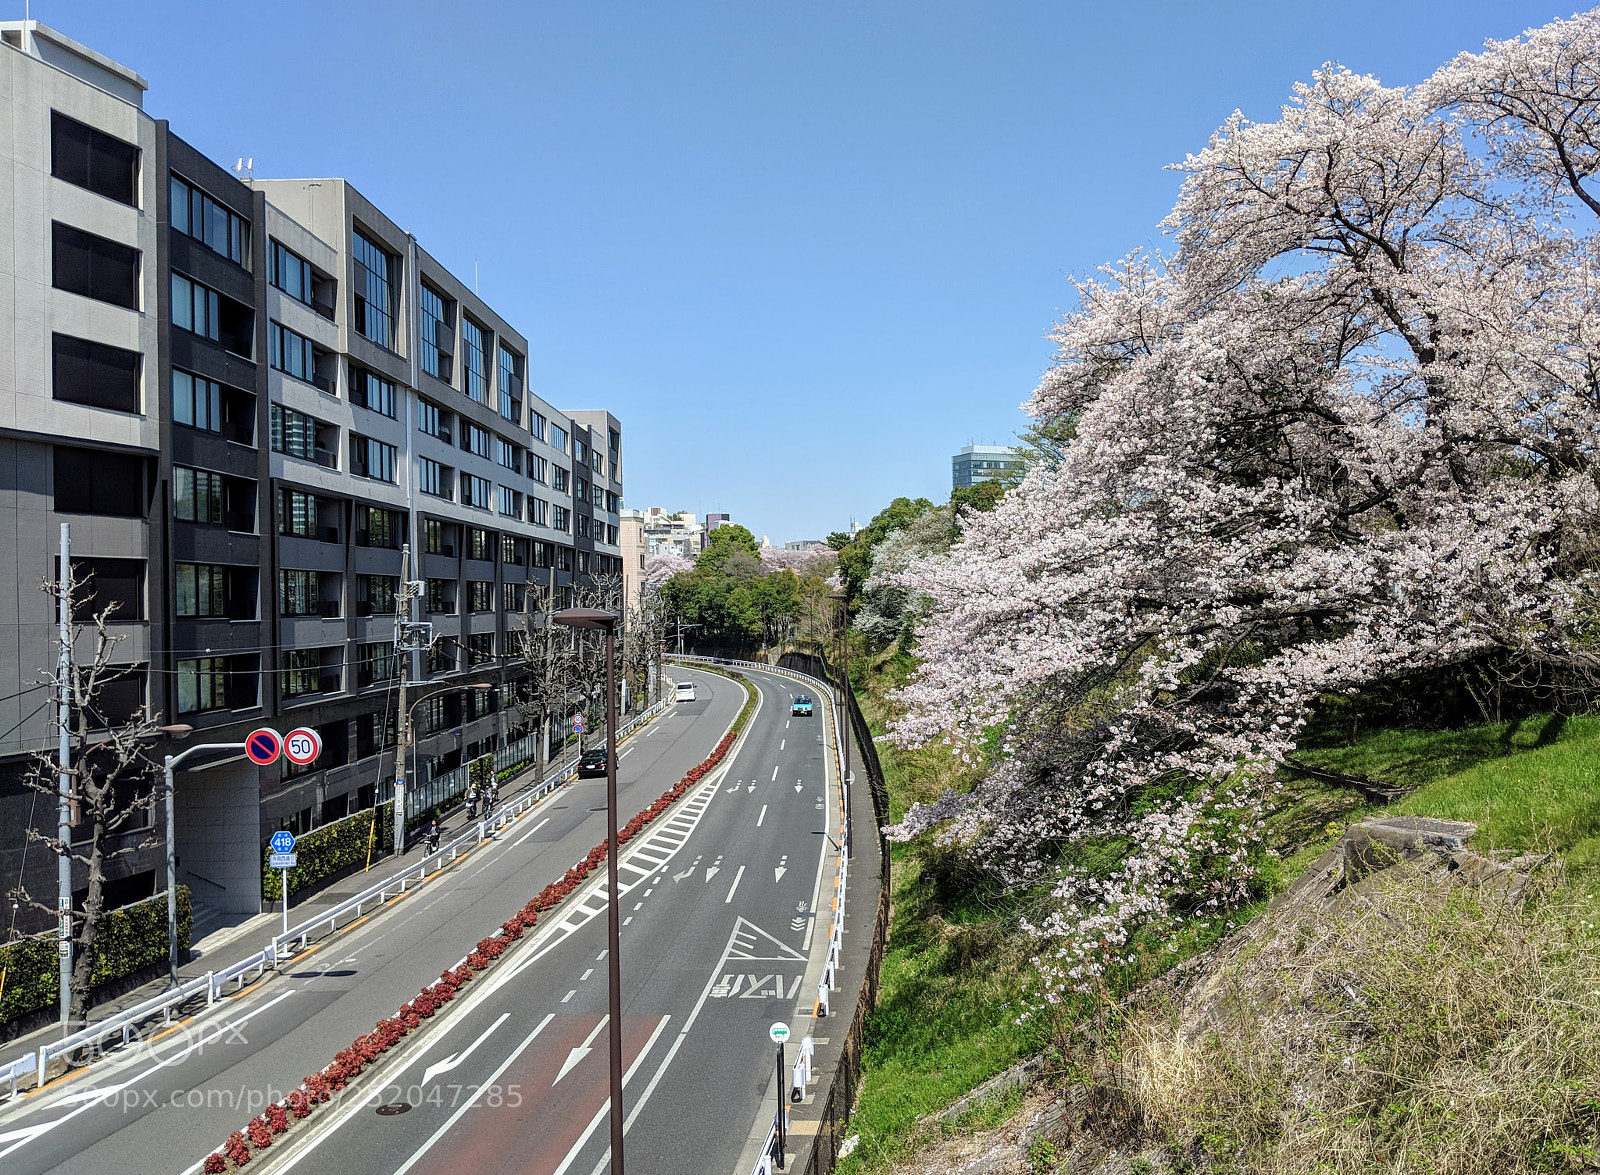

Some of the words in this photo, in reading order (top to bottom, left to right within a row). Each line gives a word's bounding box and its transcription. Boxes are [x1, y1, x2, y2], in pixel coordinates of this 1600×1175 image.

[291, 739, 311, 755] 50
[274, 837, 292, 847] 418
[708, 974, 804, 999] バス停
